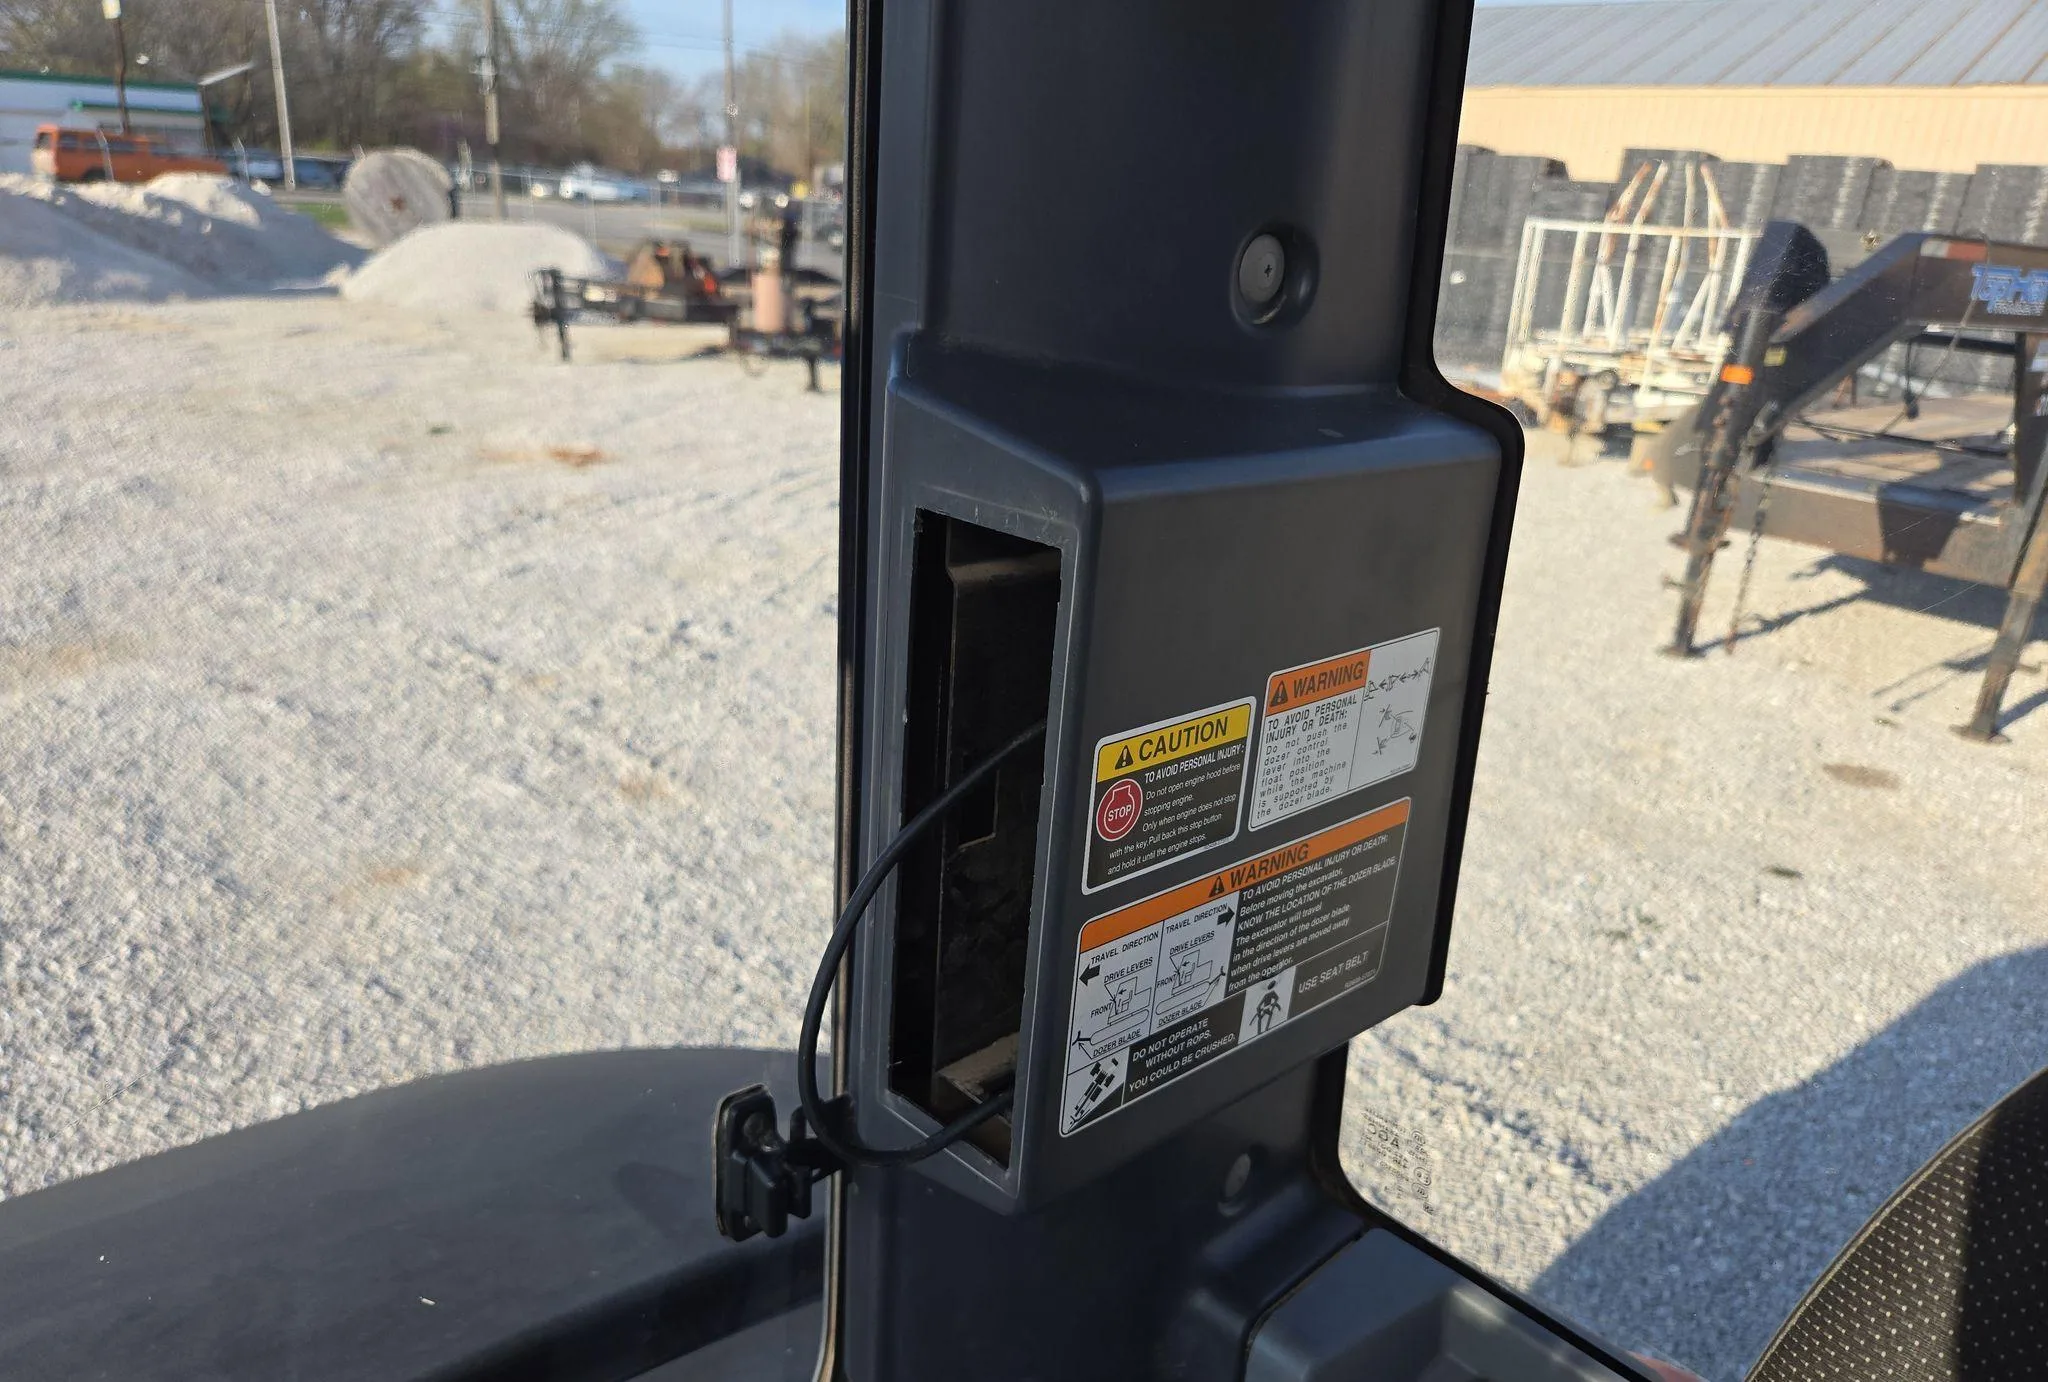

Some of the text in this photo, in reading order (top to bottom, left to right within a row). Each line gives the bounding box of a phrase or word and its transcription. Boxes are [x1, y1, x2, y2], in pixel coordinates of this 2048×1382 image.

[1293, 661, 1363, 698] WARNING
[1266, 709, 1347, 744] INJURY OR DEATH:
[1268, 694, 1357, 731] TO AVOID PERSONAL
[1139, 717, 1228, 761] CAUTION
[1264, 737, 1328, 766] dozer control
[1266, 723, 1347, 755] Do not push the
[1145, 772, 1154, 783] TO
[1156, 764, 1178, 780] AVOID
[1180, 752, 1215, 773] PERSONAL
[1260, 761, 1346, 797] while the machine
[1261, 760, 1324, 787] float position
[1262, 748, 1330, 777] lever into the
[1146, 764, 1240, 800] Do not open engine hood before
[1259, 776, 1334, 808] is supported by
[1108, 805, 1131, 821] STOP
[1143, 794, 1236, 832] Only when engine does not stop
[1144, 801, 1170, 816] stopping
[1257, 787, 1332, 819] the dozer blade.
[1110, 848, 1122, 859] with
[1124, 844, 1134, 853] the
[1161, 829, 1176, 841] back
[1178, 824, 1188, 834] this
[1190, 820, 1202, 830] stop
[1204, 813, 1221, 826] button
[1108, 865, 1120, 875] and
[1122, 859, 1136, 869] hold
[1137, 856, 1140, 864] it
[1142, 851, 1155, 862] until
[1157, 848, 1167, 857] the
[1168, 840, 1188, 852] engine
[1230, 843, 1309, 888] WARNING
[1243, 889, 1253, 901] TO
[1255, 878, 1280, 896] AVOID
[1282, 860, 1322, 885] PERSONAL
[1324, 849, 1350, 868] INJURY
[1352, 845, 1362, 856] OR
[1238, 913, 1263, 932] KNOW
[1265, 906, 1280, 920] THE
[1282, 889, 1320, 913] LOCATION
[1322, 884, 1333, 895] OF
[1334, 877, 1347, 890] THE
[1348, 866, 1372, 884] DOZER
[1240, 900, 1265, 917] Before
[1267, 888, 1294, 905] moving
[1296, 883, 1307, 893] the
[1166, 903, 1228, 934] TRAVEL DIRECTION
[1233, 904, 1350, 962] in the direction of the dozer blade
[1236, 901, 1322, 946] The excavator will travel
[1091, 931, 1159, 965] TRAVEL DIRECTION
[1170, 930, 1215, 955] DRIVE LEVERS
[1231, 917, 1349, 976] when drive levers are moved away
[1104, 957, 1153, 983] DRIVE LEVERS
[1157, 974, 1176, 988] FRONT
[1228, 978, 1246, 991] from
[1248, 972, 1260, 982] the
[1299, 976, 1318, 993] USE
[1320, 963, 1344, 983] SEAT
[1345, 951, 1368, 970] BELT
[1091, 1002, 1112, 1018] FRONT
[1158, 1000, 1202, 1026] DOZER BLADE
[1093, 1030, 1141, 1057] DOZER BLADE
[1132, 1018, 1208, 1062] DO NOT OPERATE
[1145, 1042, 1186, 1068] WITHOUT
[1129, 1033, 1235, 1092] YOU COULD BE CRUSHED.
